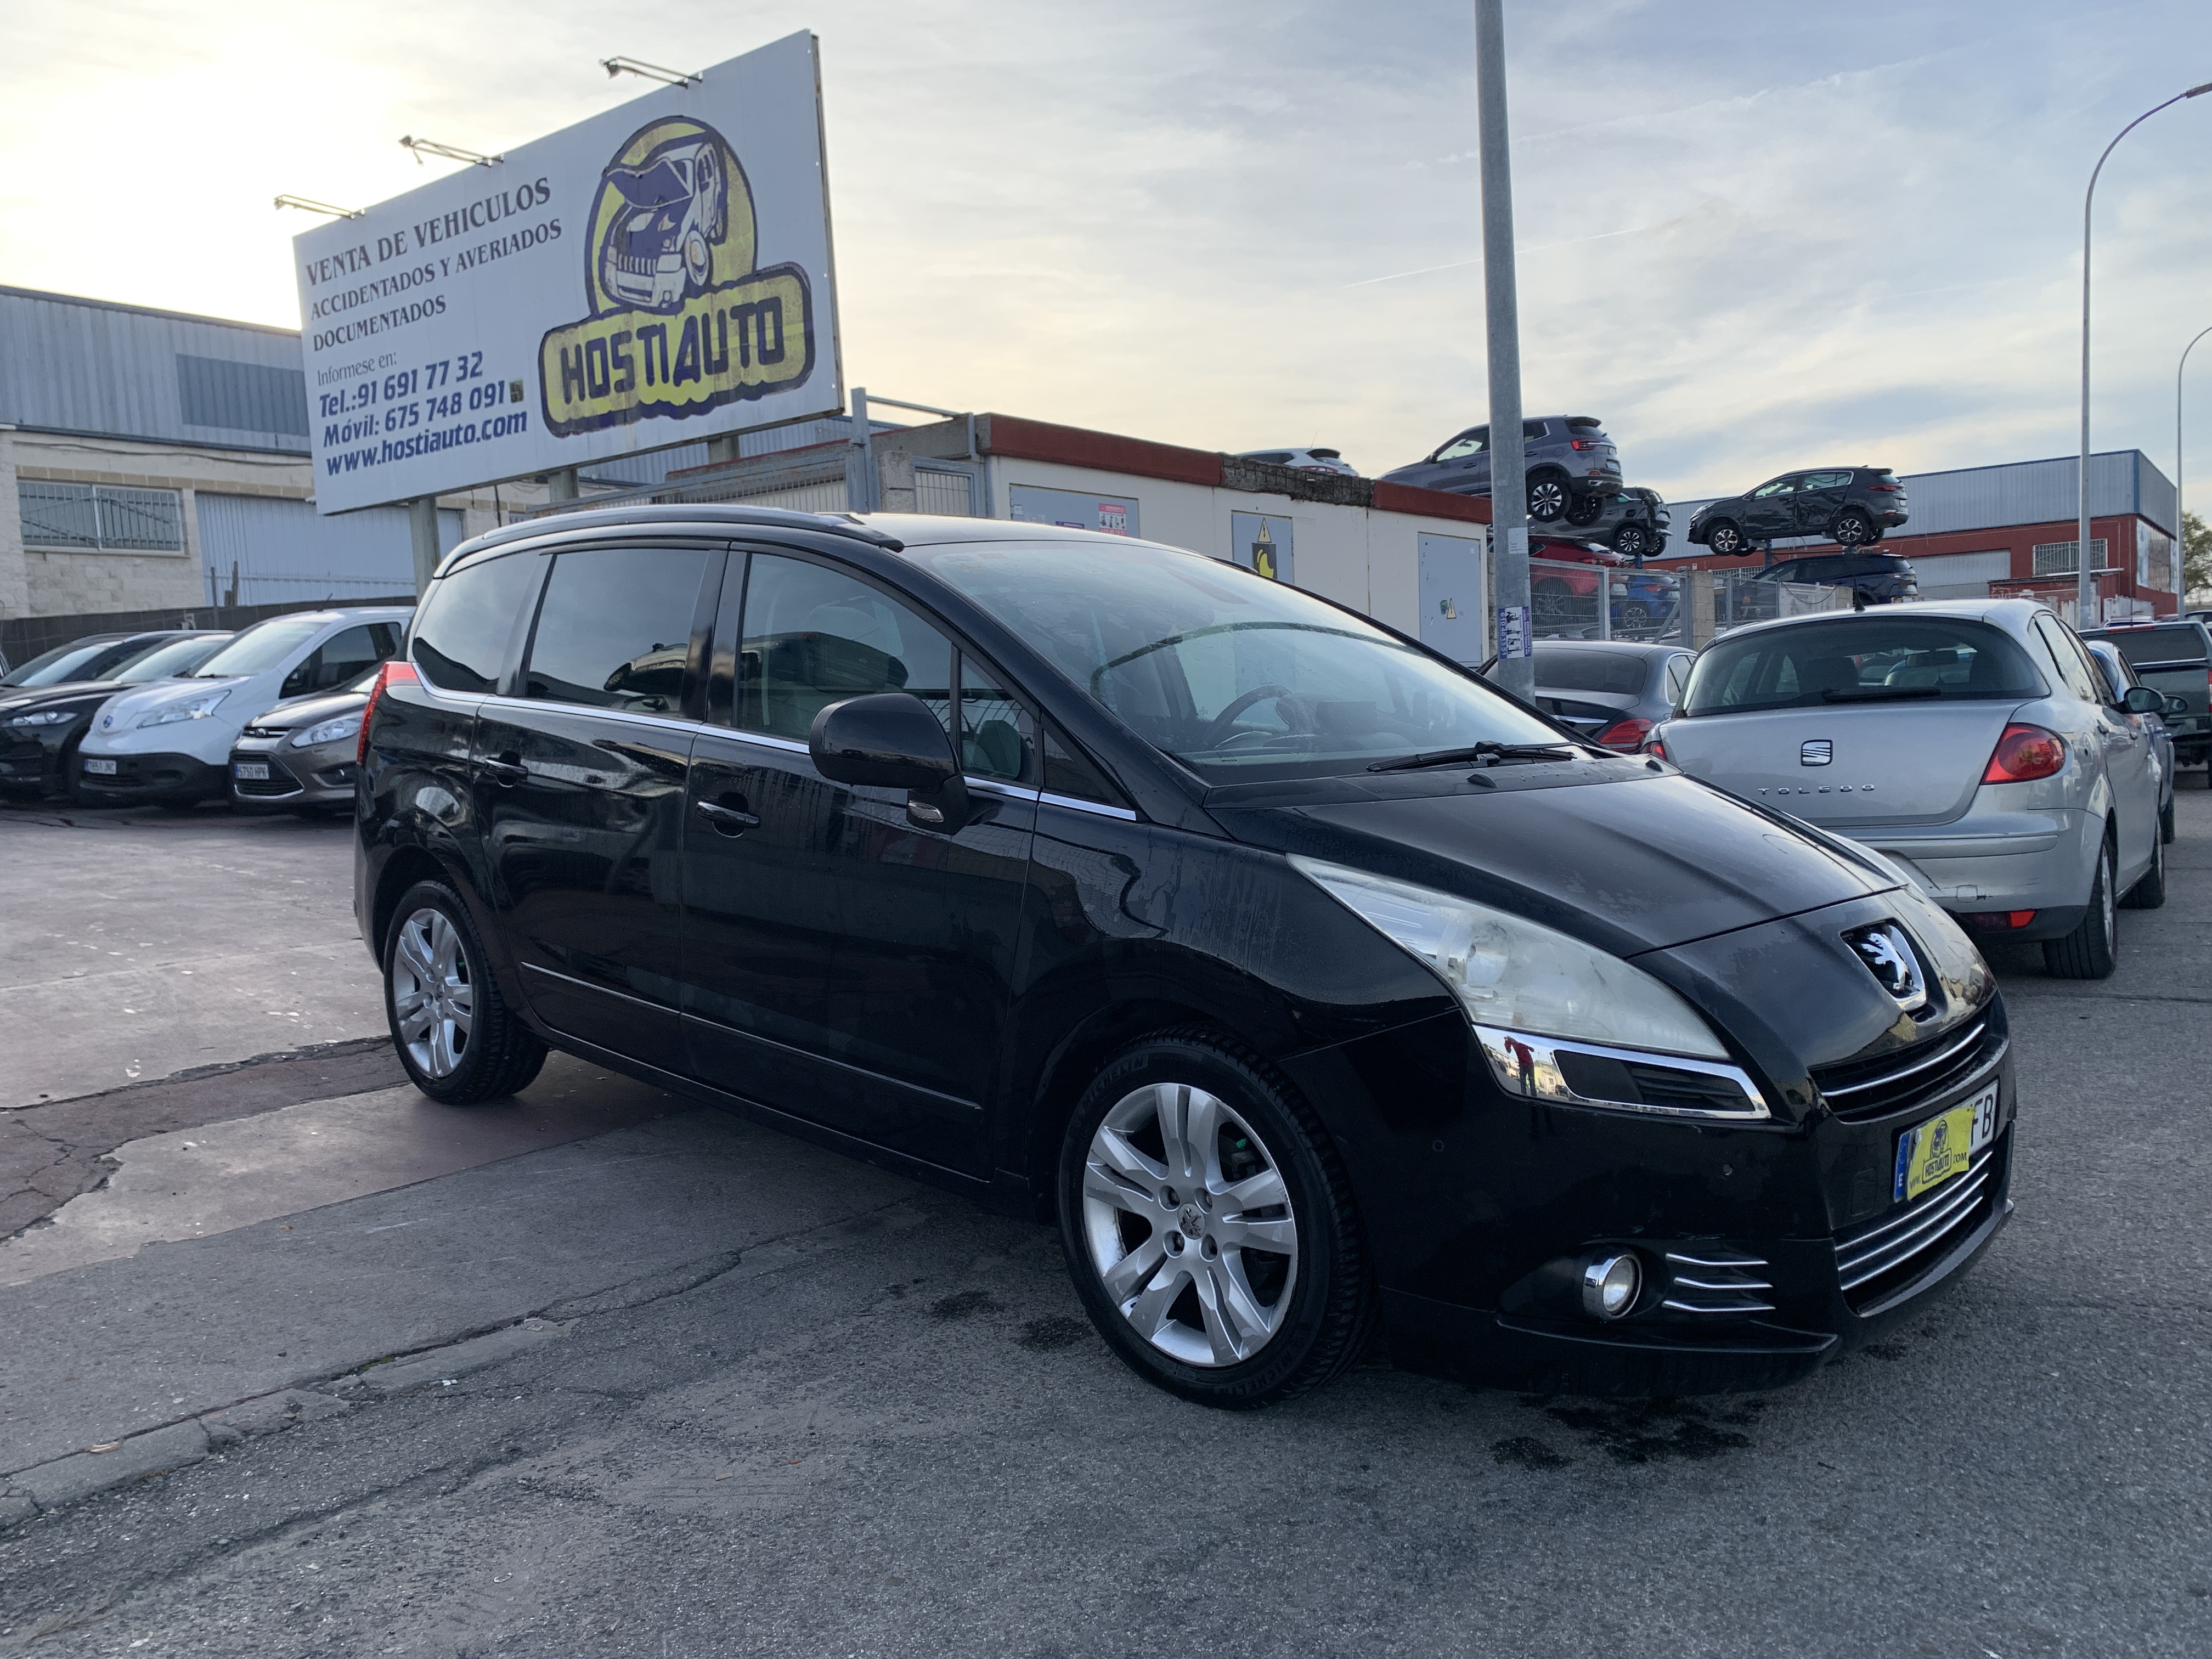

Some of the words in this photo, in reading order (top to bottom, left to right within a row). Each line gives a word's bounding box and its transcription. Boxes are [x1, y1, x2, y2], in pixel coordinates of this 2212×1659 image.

[306, 245, 371, 285] VENTA
[377, 231, 408, 262] DE
[414, 177, 550, 248] VEHICULOS
[311, 263, 435, 320] ACCIDENTADOS
[440, 257, 450, 277] Y
[456, 218, 562, 273] AVERIADOS
[313, 295, 446, 352] DOCUMENTADOS
[561, 296, 785, 405] HOSTIAUTO
[318, 358, 375, 386] Informese
[379, 352, 397, 369] en:
[384, 369, 418, 400] 691
[425, 359, 450, 390] 77
[456, 351, 483, 382] 32
[323, 414, 380, 447] Móvil:
[385, 402, 419, 432] 675
[426, 392, 462, 422] 748
[469, 380, 505, 410] 091
[326, 411, 527, 476] www.hostiauto.com
[1758, 783, 1875, 795] TOLEDO
[1898, 1172, 1904, 1188] E
